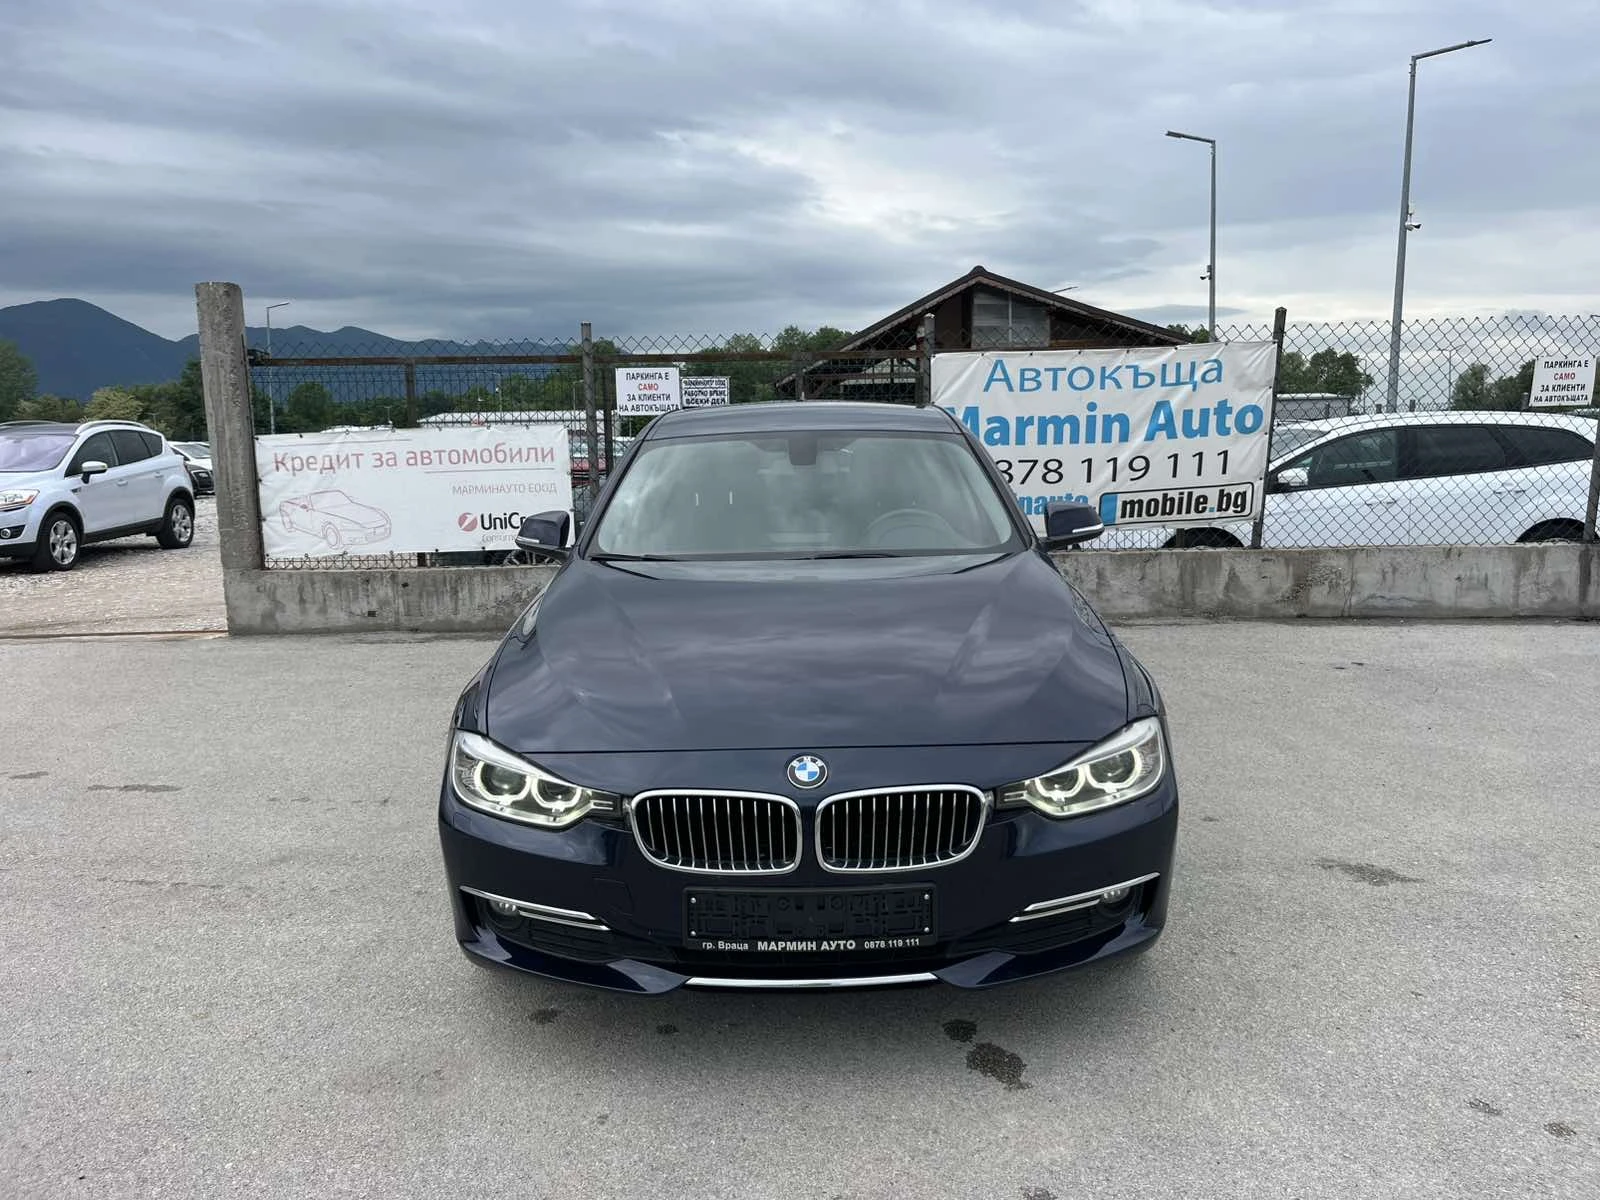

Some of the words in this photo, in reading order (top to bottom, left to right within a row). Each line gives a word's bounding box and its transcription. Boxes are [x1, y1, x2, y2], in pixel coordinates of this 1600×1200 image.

[1543, 360, 1582, 369] ПАРКИНГА
[1584, 360, 1589, 368] Е
[625, 372, 662, 380] ПАРКИНГА
[664, 372, 669, 380] Е
[983, 358, 1223, 393] Автокъща
[1553, 372, 1576, 381] САМО
[638, 383, 659, 391] САМО
[1540, 385, 1549, 393] ЗА
[1551, 384, 1586, 392] КЛИЕНТИ
[626, 394, 637, 402] ЗА
[638, 393, 671, 402] КЛИЕНТИ
[619, 404, 630, 412] НА
[631, 404, 680, 412] АВТОКЪЩАТА
[1143, 399, 1264, 442] Auto
[273, 451, 365, 477] Кредит
[371, 450, 398, 469] за
[406, 442, 555, 467] автомобили
[1081, 455, 1151, 484] 119
[1167, 449, 1230, 478] 111
[451, 483, 526, 496] МАРМИНАУТО
[528, 482, 558, 495] ЕООД
[1120, 489, 1247, 519] mobile.bg
[702, 941, 716, 951] гр.
[718, 940, 749, 952] Враца
[757, 941, 817, 951] МАРМИН
[820, 940, 856, 951] АУТО
[864, 940, 886, 949] 0878
[888, 939, 903, 948] 119
[905, 938, 920, 946] 111
